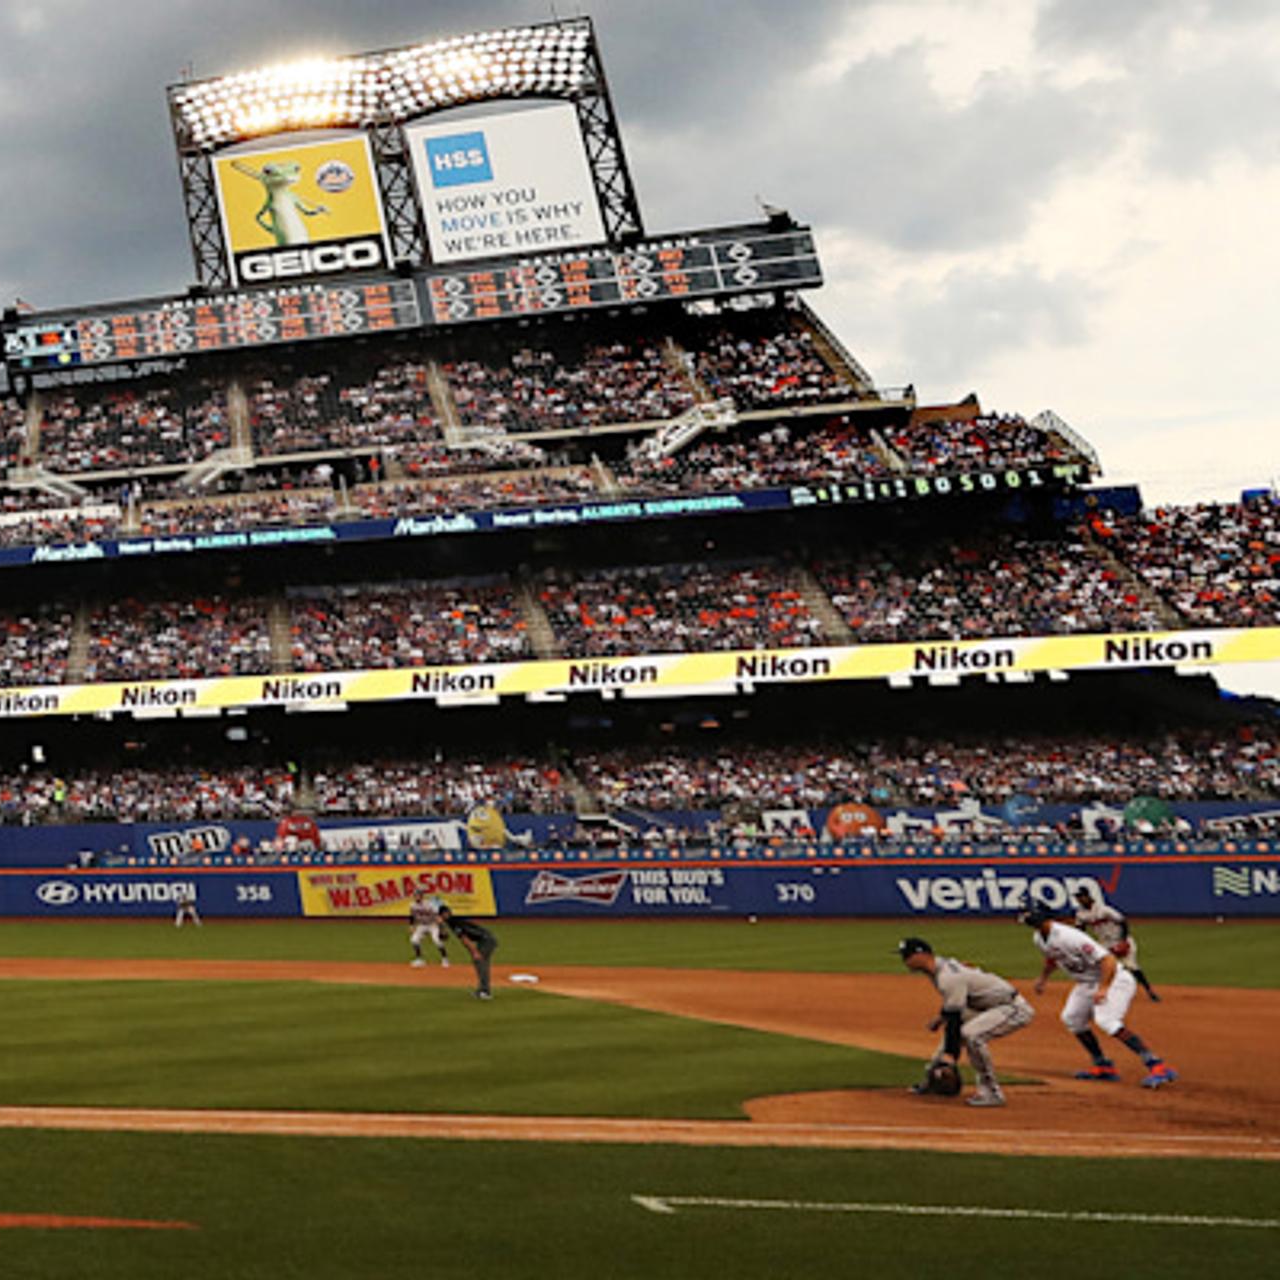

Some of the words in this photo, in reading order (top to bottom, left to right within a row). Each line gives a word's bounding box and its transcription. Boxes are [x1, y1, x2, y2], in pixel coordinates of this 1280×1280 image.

[434, 149, 484, 171] HSS
[437, 194, 486, 212] HOW
[492, 188, 536, 205] YOU
[441, 211, 502, 232] MOVE
[506, 208, 527, 224] IS
[533, 201, 583, 220] WHY
[444, 234, 511, 253] WE'RE
[515, 224, 580, 245] HERE.
[240, 240, 382, 281] GEICO
[394, 513, 478, 535] Marshalls
[32, 540, 104, 563] Marshalls
[913, 646, 1015, 671] Nikon
[1104, 636, 1214, 664] Nikon
[567, 662, 658, 687] Nikon
[735, 653, 831, 679] Nikon
[262, 678, 342, 701] Nikon
[411, 671, 496, 694] Nikon
[121, 685, 197, 708] Nikon
[630, 869, 670, 885] THIS
[83, 882, 196, 901] HYUNDAI
[236, 885, 272, 901] 358
[633, 886, 668, 904] FOR
[775, 883, 816, 901] 370
[896, 868, 1106, 912] verizon
